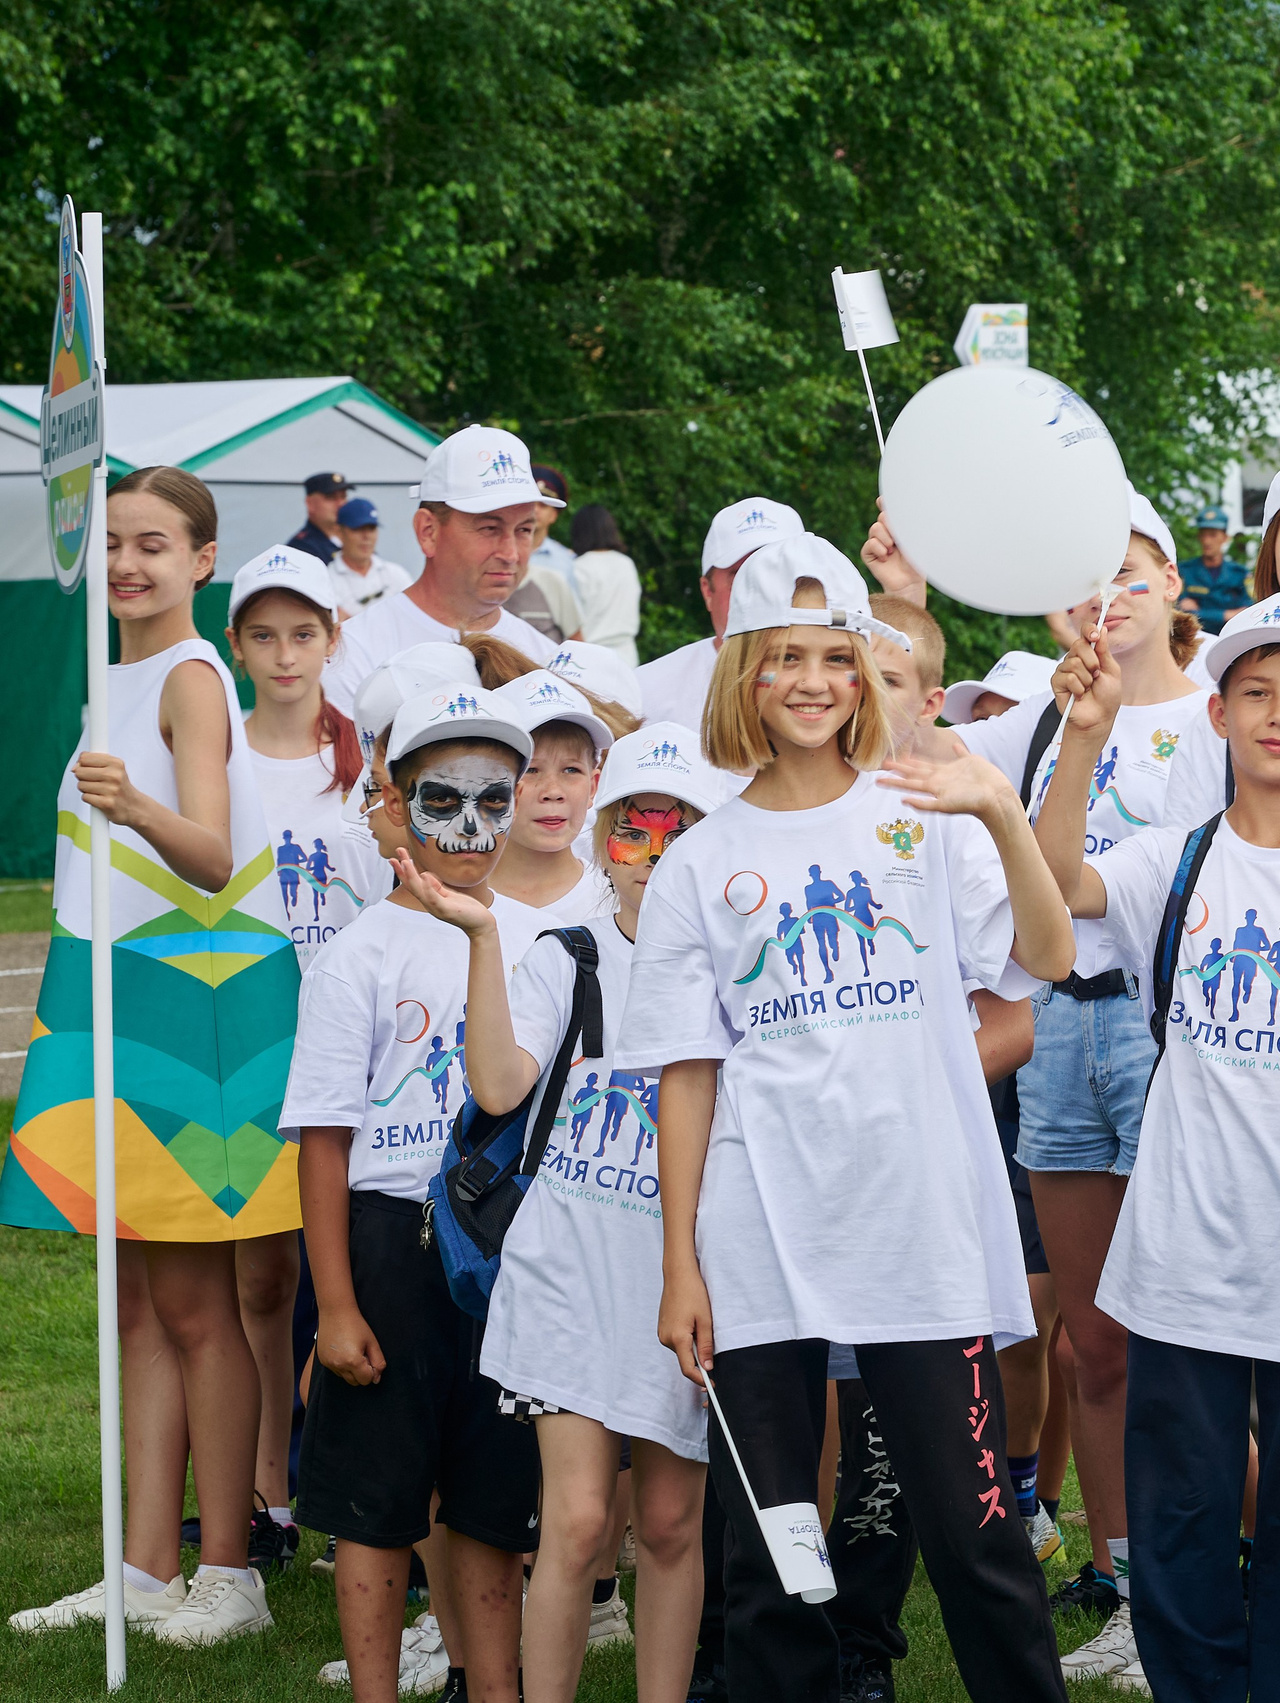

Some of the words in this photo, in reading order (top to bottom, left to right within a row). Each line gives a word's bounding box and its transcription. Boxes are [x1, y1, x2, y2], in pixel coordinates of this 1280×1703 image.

[43, 377, 98, 470] Целинный
[637, 761, 661, 770] ЗЕМЛЯ
[662, 762, 691, 775] СПОРТА
[761, 1012, 863, 1042] ВСЕРОССИЙСКИЙ
[869, 1010, 920, 1023] МАРАФО
[388, 1148, 442, 1162] ВСЕРОСС
[596, 1165, 660, 1198] СПО
[620, 1200, 662, 1219] МАРАФ
